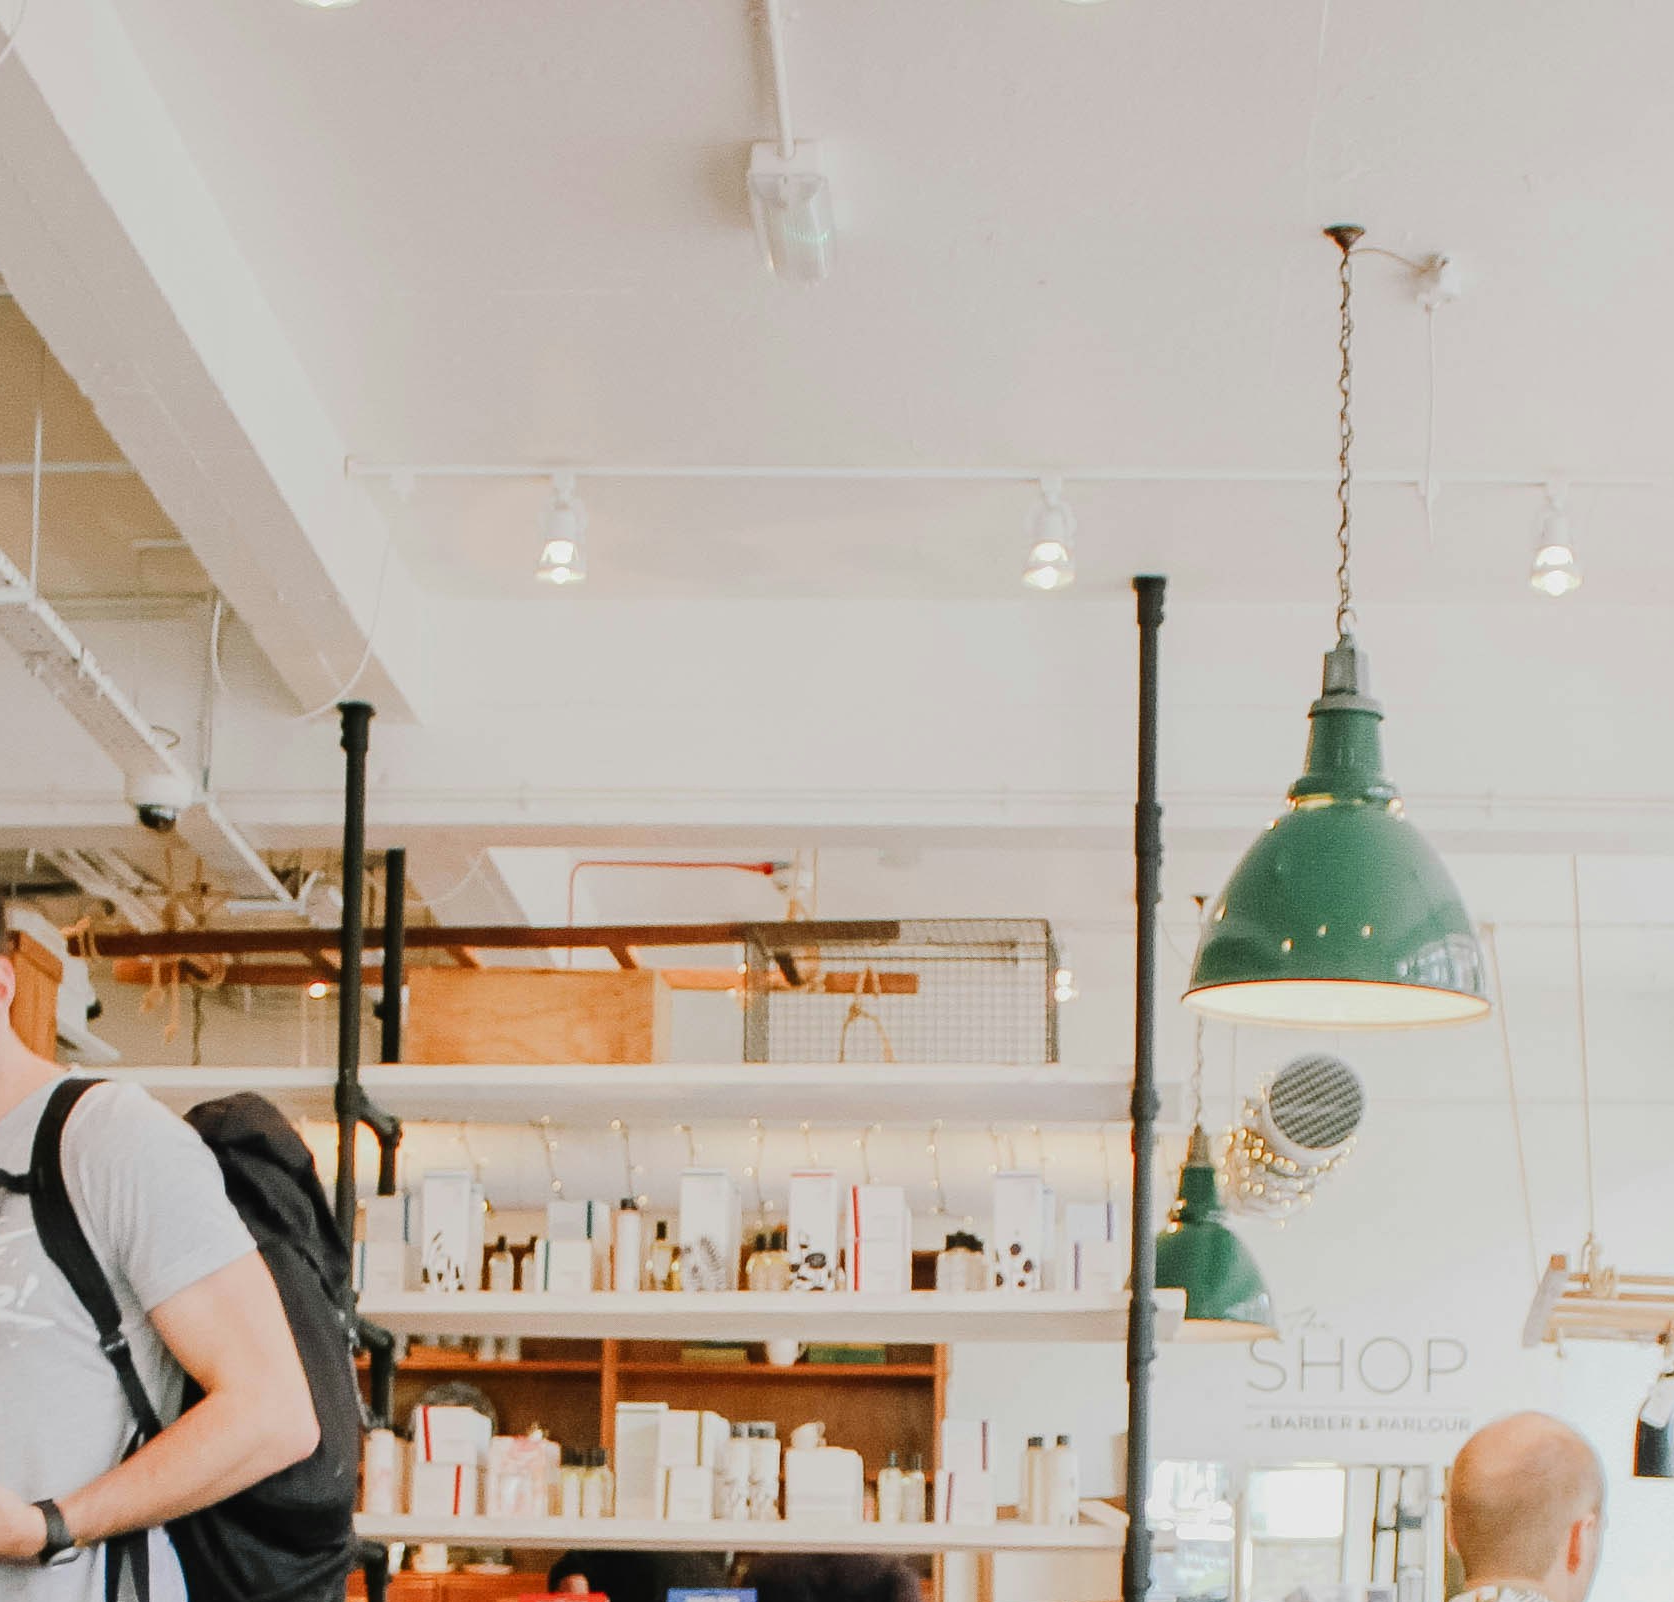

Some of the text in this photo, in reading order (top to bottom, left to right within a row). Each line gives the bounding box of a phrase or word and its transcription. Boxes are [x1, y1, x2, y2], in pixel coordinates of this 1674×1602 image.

[1246, 1335, 1468, 1395] SHOP
[1268, 1415, 1353, 1432] BARBER
[1376, 1416, 1472, 1433] PARLOUR
